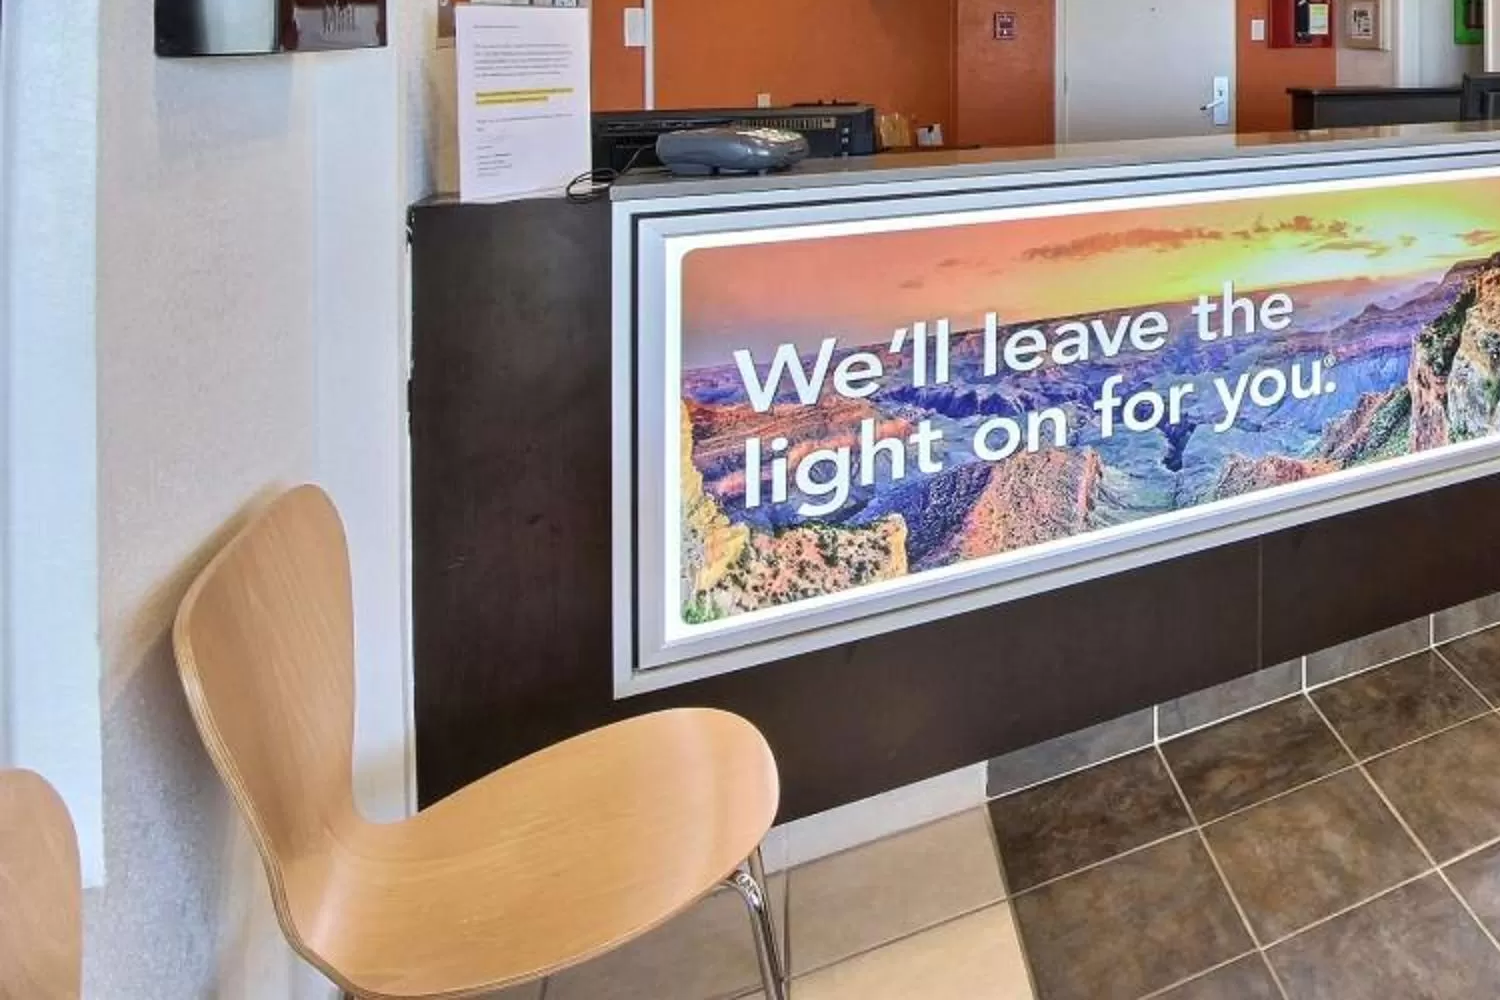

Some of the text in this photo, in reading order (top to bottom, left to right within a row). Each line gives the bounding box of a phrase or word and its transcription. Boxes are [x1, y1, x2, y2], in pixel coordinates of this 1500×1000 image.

[734, 281, 1294, 414] We'll leave the
[744, 418, 944, 516] light
[973, 404, 1068, 464] on
[1096, 374, 1194, 438] for
